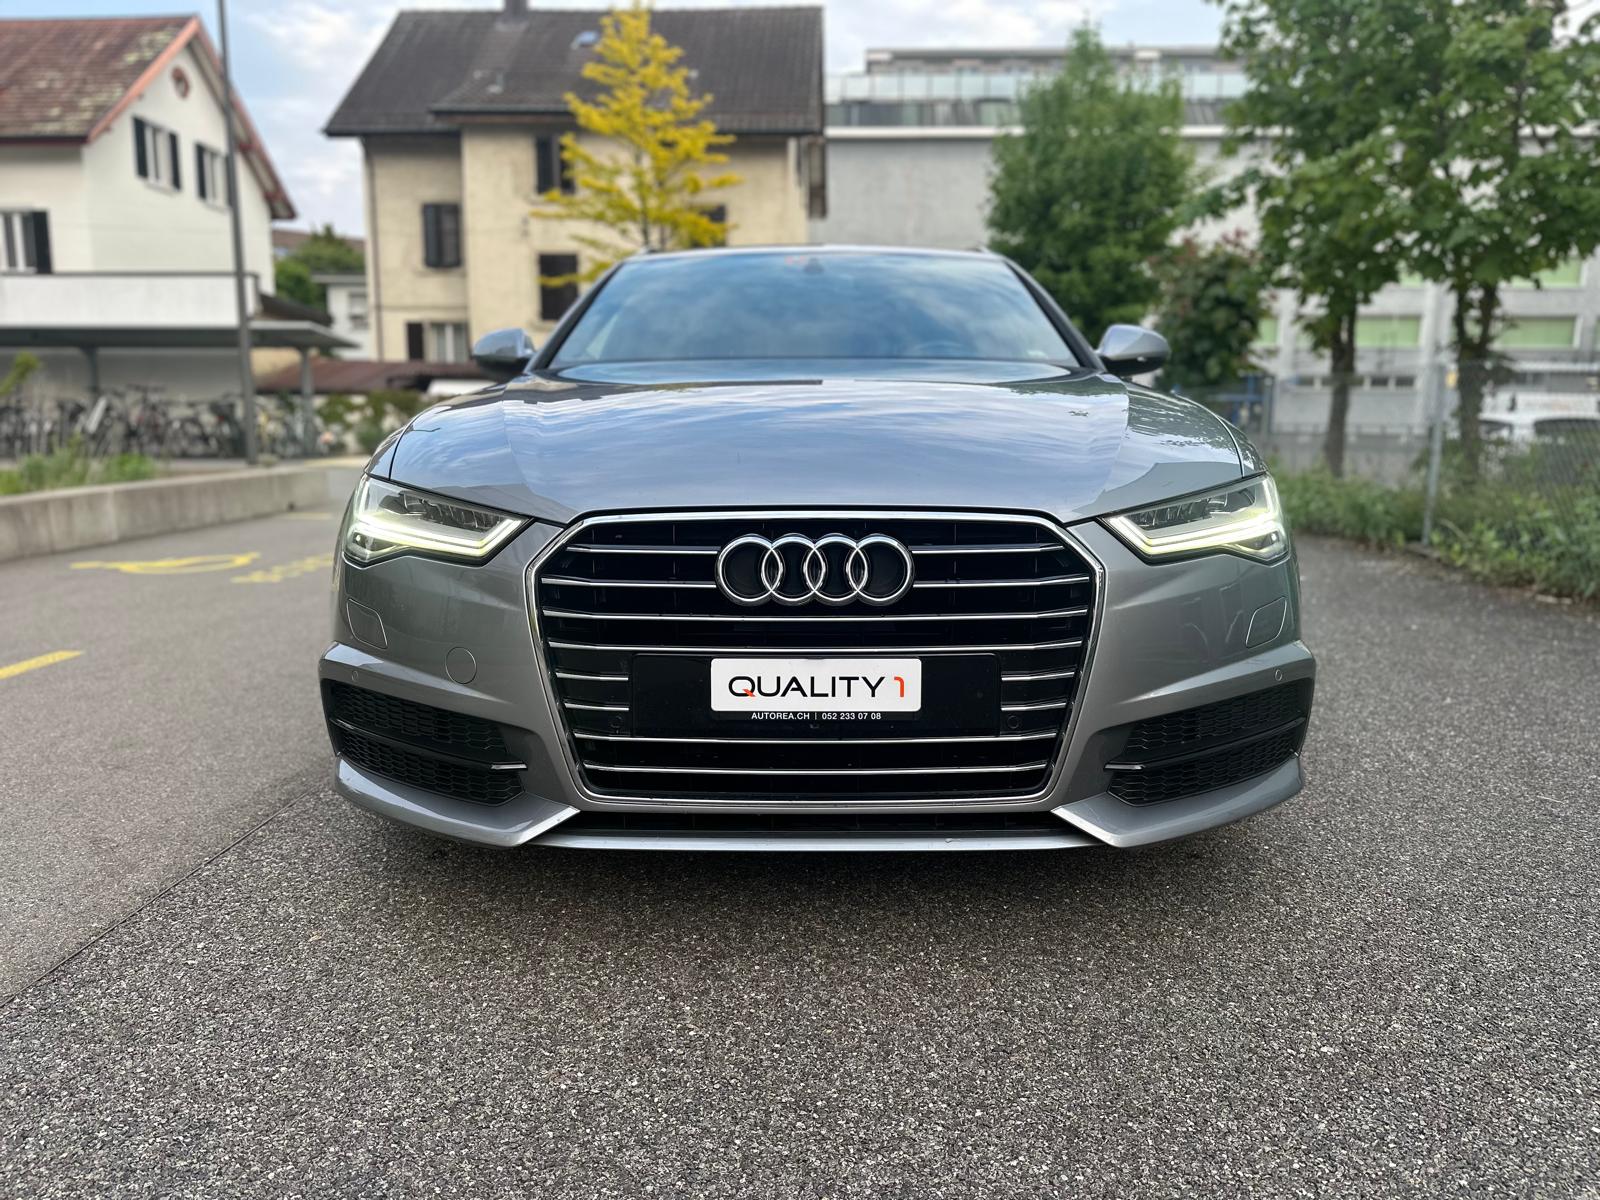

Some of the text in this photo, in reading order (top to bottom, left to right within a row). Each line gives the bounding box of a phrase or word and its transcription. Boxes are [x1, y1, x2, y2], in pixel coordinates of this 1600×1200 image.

[728, 675, 905, 698] QUALITY 1
[751, 712, 882, 720] AUTOREA.CH 052 233 07 08
